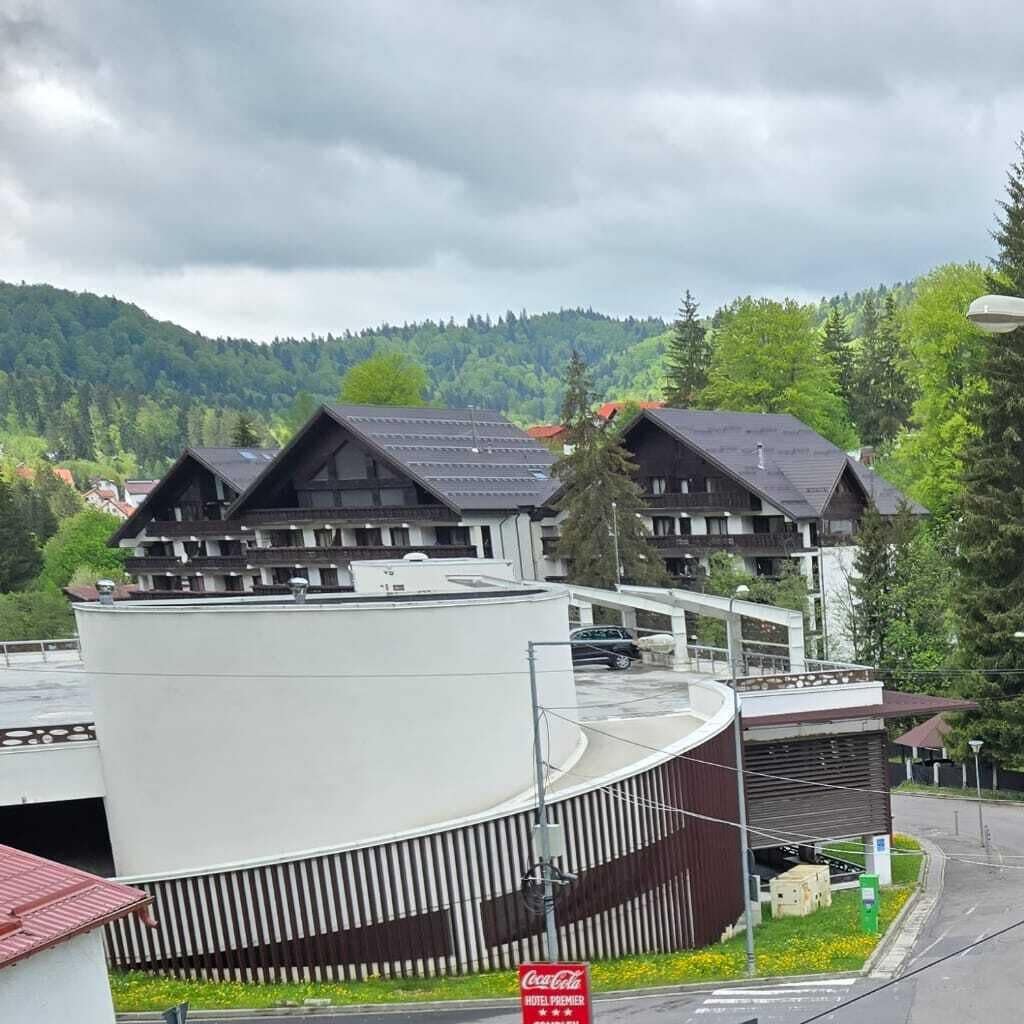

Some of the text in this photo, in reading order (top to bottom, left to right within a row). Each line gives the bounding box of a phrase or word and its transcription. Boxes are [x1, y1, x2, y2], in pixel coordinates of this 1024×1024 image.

[522, 969, 585, 990] Coca-Cola
[525, 995, 585, 1006] HOTEL PREMIER
